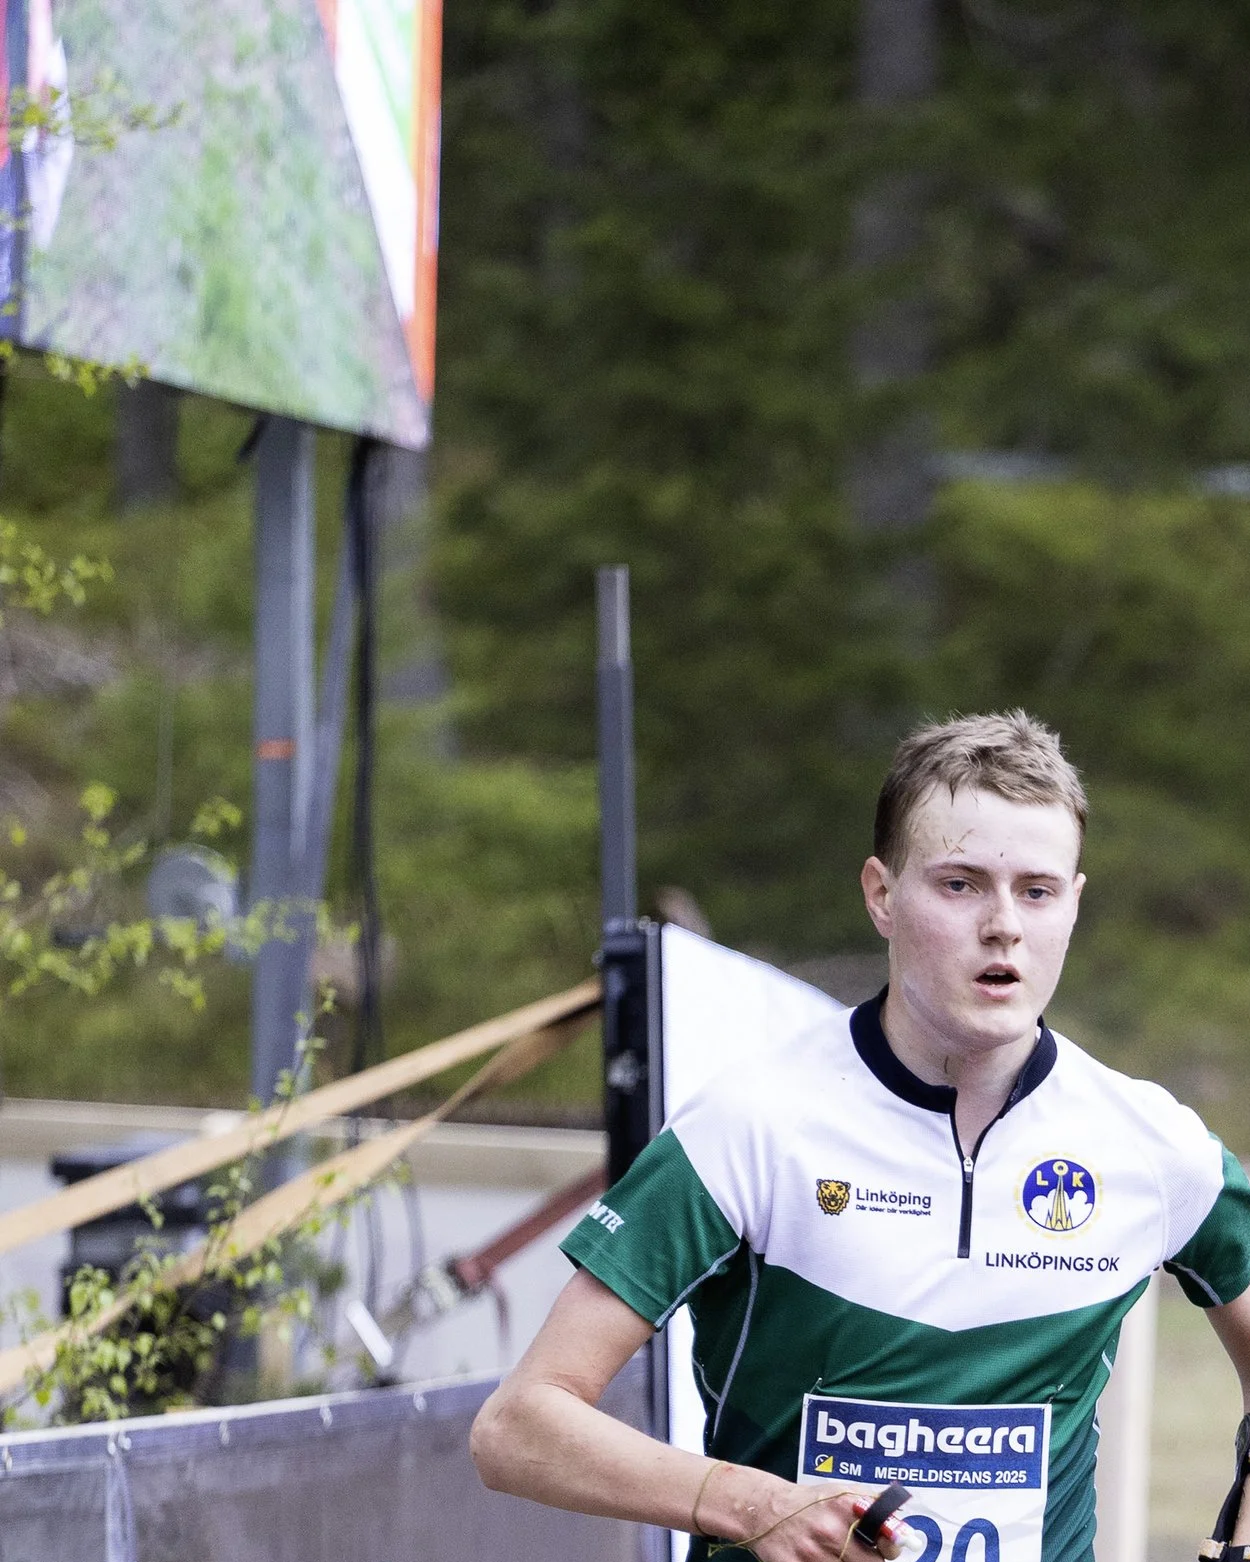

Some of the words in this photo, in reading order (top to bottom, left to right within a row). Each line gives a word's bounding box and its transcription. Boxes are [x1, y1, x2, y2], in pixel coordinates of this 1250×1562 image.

[856, 1188, 932, 1209] Linköping
[985, 1252, 1094, 1272] LINKÖPINGS
[1097, 1257, 1120, 1272] OK
[816, 1411, 1035, 1458] bagheera
[839, 1461, 862, 1476] SM
[874, 1466, 992, 1483] MEDELDISTANS
[995, 1470, 1027, 1484] 2025
